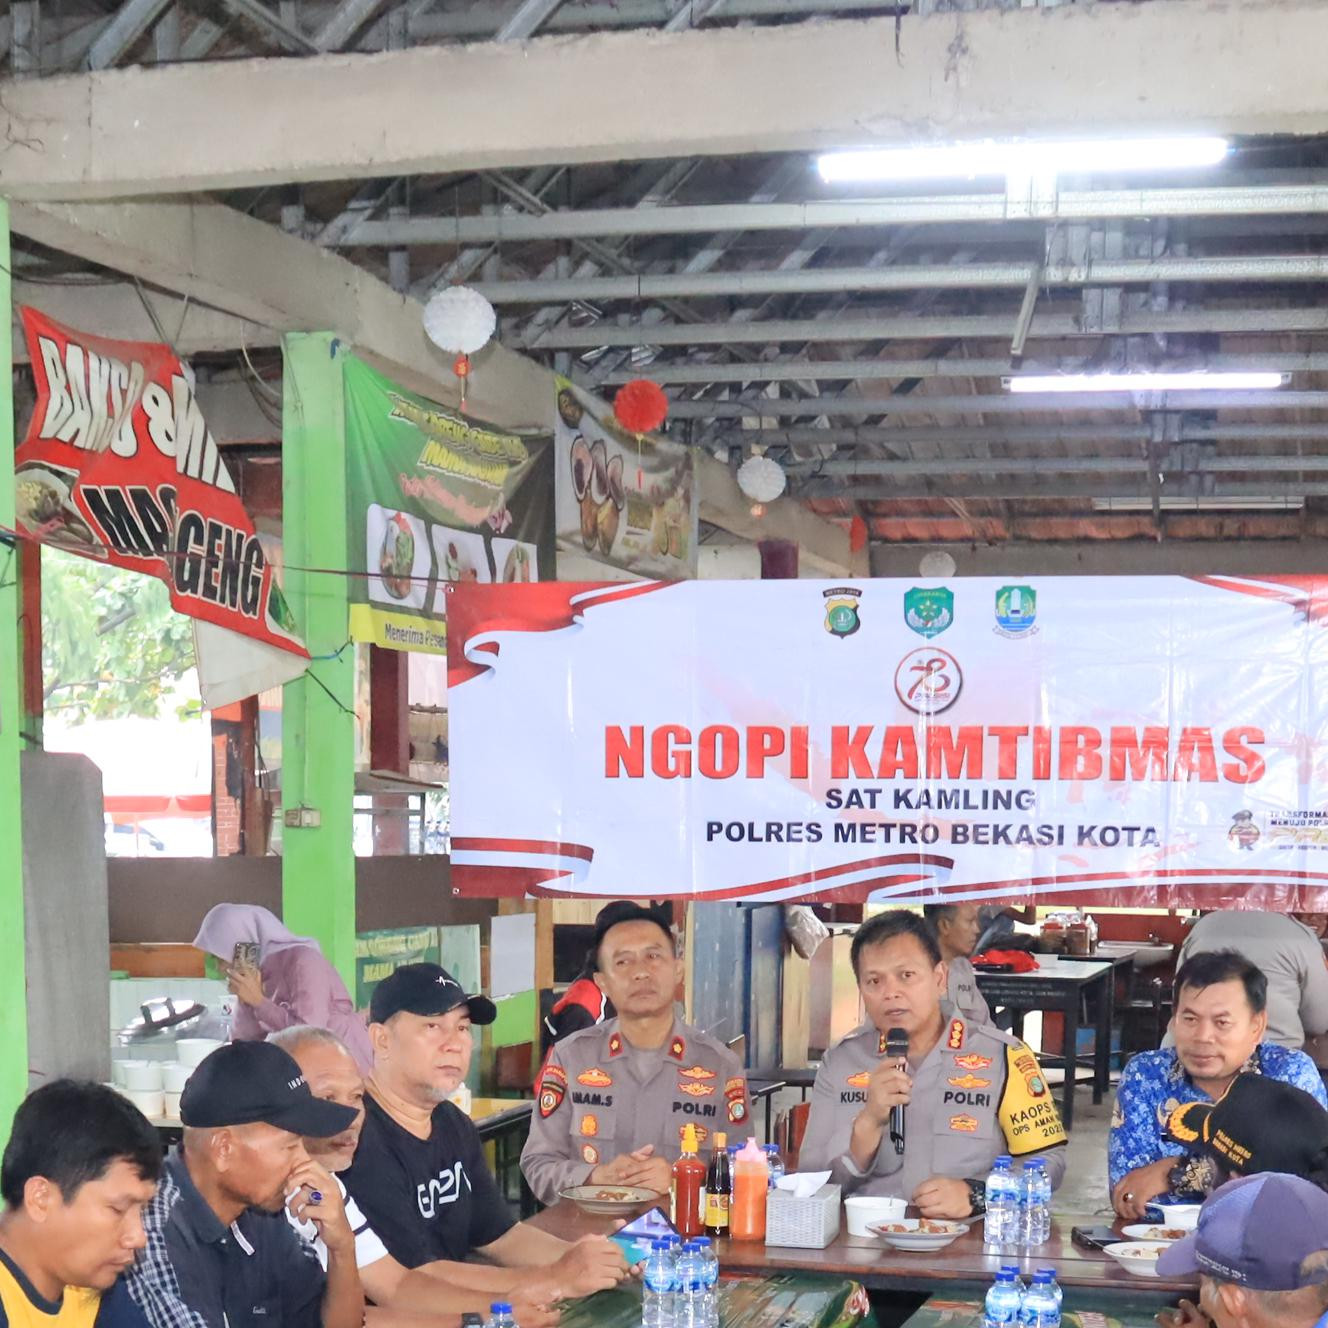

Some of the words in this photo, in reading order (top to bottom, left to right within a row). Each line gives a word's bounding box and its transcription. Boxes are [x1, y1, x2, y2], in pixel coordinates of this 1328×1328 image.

[384, 622, 424, 646] Menerima
[604, 724, 809, 780] NGOPI
[831, 724, 1266, 784] KAMTIBMAS
[825, 787, 882, 811] SAT
[891, 786, 1037, 812] KAMLING
[706, 821, 826, 846] POLRES
[833, 821, 940, 846] METRO
[949, 821, 1066, 847] BEKASI
[1075, 822, 1161, 849] KOTA
[672, 1101, 717, 1118] POLRI
[943, 1091, 991, 1108] POLRI
[1009, 1101, 1052, 1125] KAOPS
[1012, 1124, 1030, 1136] OPS
